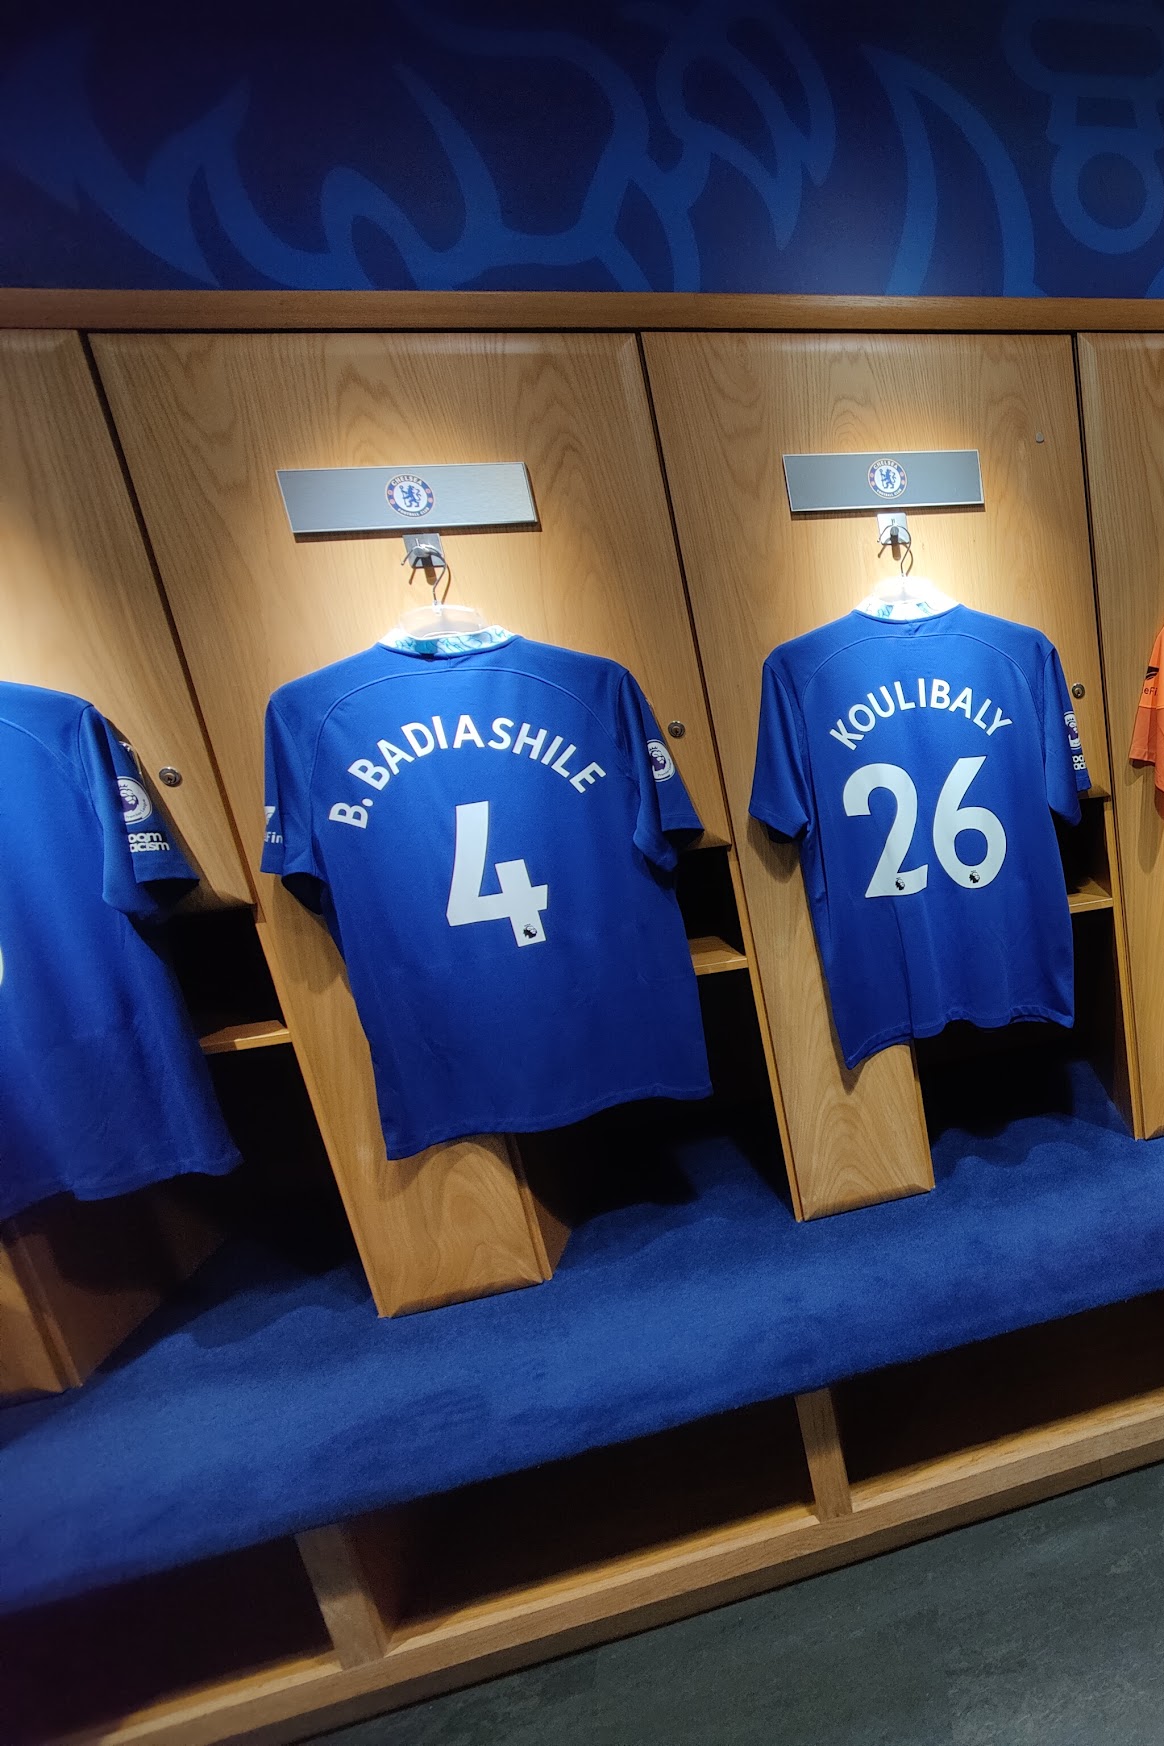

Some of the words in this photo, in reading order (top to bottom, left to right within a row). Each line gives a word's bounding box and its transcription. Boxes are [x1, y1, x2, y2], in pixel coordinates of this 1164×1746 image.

[873, 461, 898, 469] CHELSEA
[391, 476, 422, 486] CHELSEA
[829, 677, 1013, 751] KOULIBALY
[842, 755, 1007, 898] 26
[128, 832, 162, 843] oom
[263, 831, 284, 844] Fin
[129, 842, 170, 852] acism
[445, 800, 548, 948] 4
